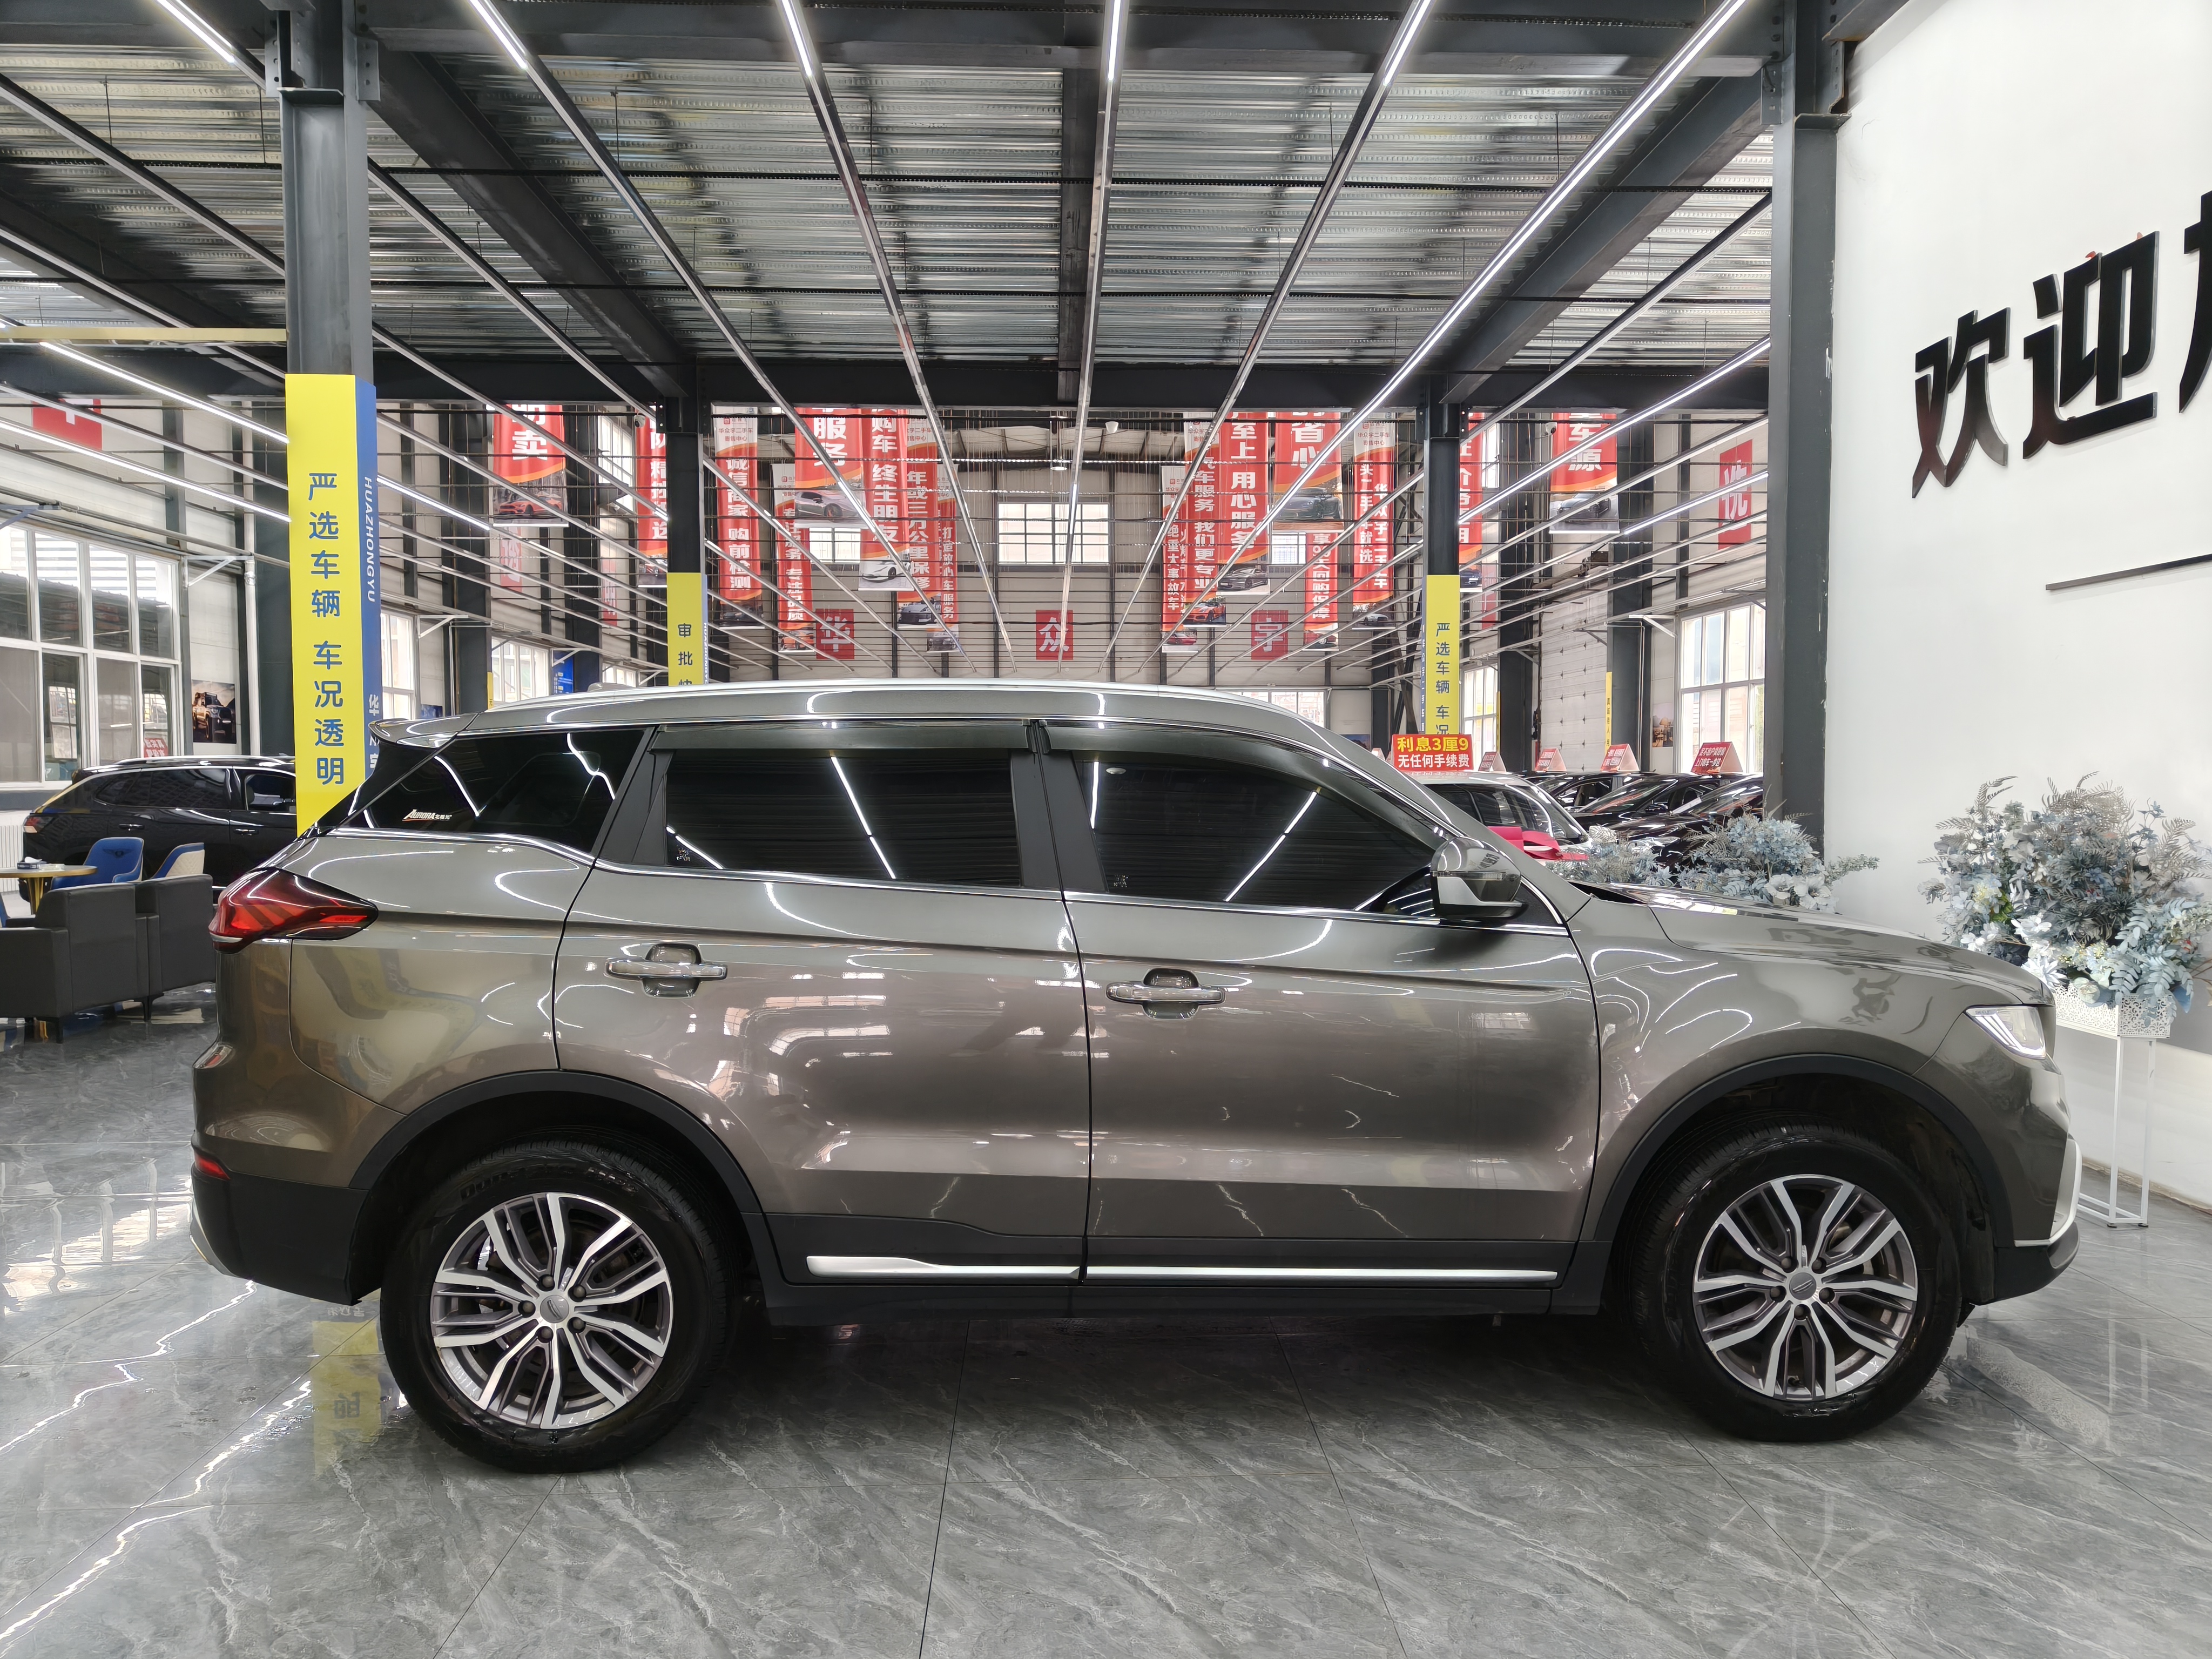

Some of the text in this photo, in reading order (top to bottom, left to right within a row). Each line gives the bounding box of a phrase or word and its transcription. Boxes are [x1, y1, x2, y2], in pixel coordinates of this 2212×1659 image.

[812, 408, 847, 466] 服务
[1291, 412, 1325, 469] 省心
[1568, 413, 1602, 471] 车源
[871, 409, 898, 542] 购车 终生朋友
[1231, 412, 1257, 549] 至上 用心服务
[365, 476, 375, 602] HUAZHONGYU
[726, 458, 751, 590] 诚信商家 购前检测
[1195, 522, 1215, 589] 我们更专业
[308, 473, 345, 785] 严选车辆 车况透明
[820, 616, 851, 652] 华
[1038, 617, 1069, 652] 众
[1254, 617, 1284, 652] 宇
[1435, 623, 1450, 694] 严选车辆
[1397, 737, 1468, 752] 利息3厘9
[1398, 754, 1469, 768] 无任何手续费
